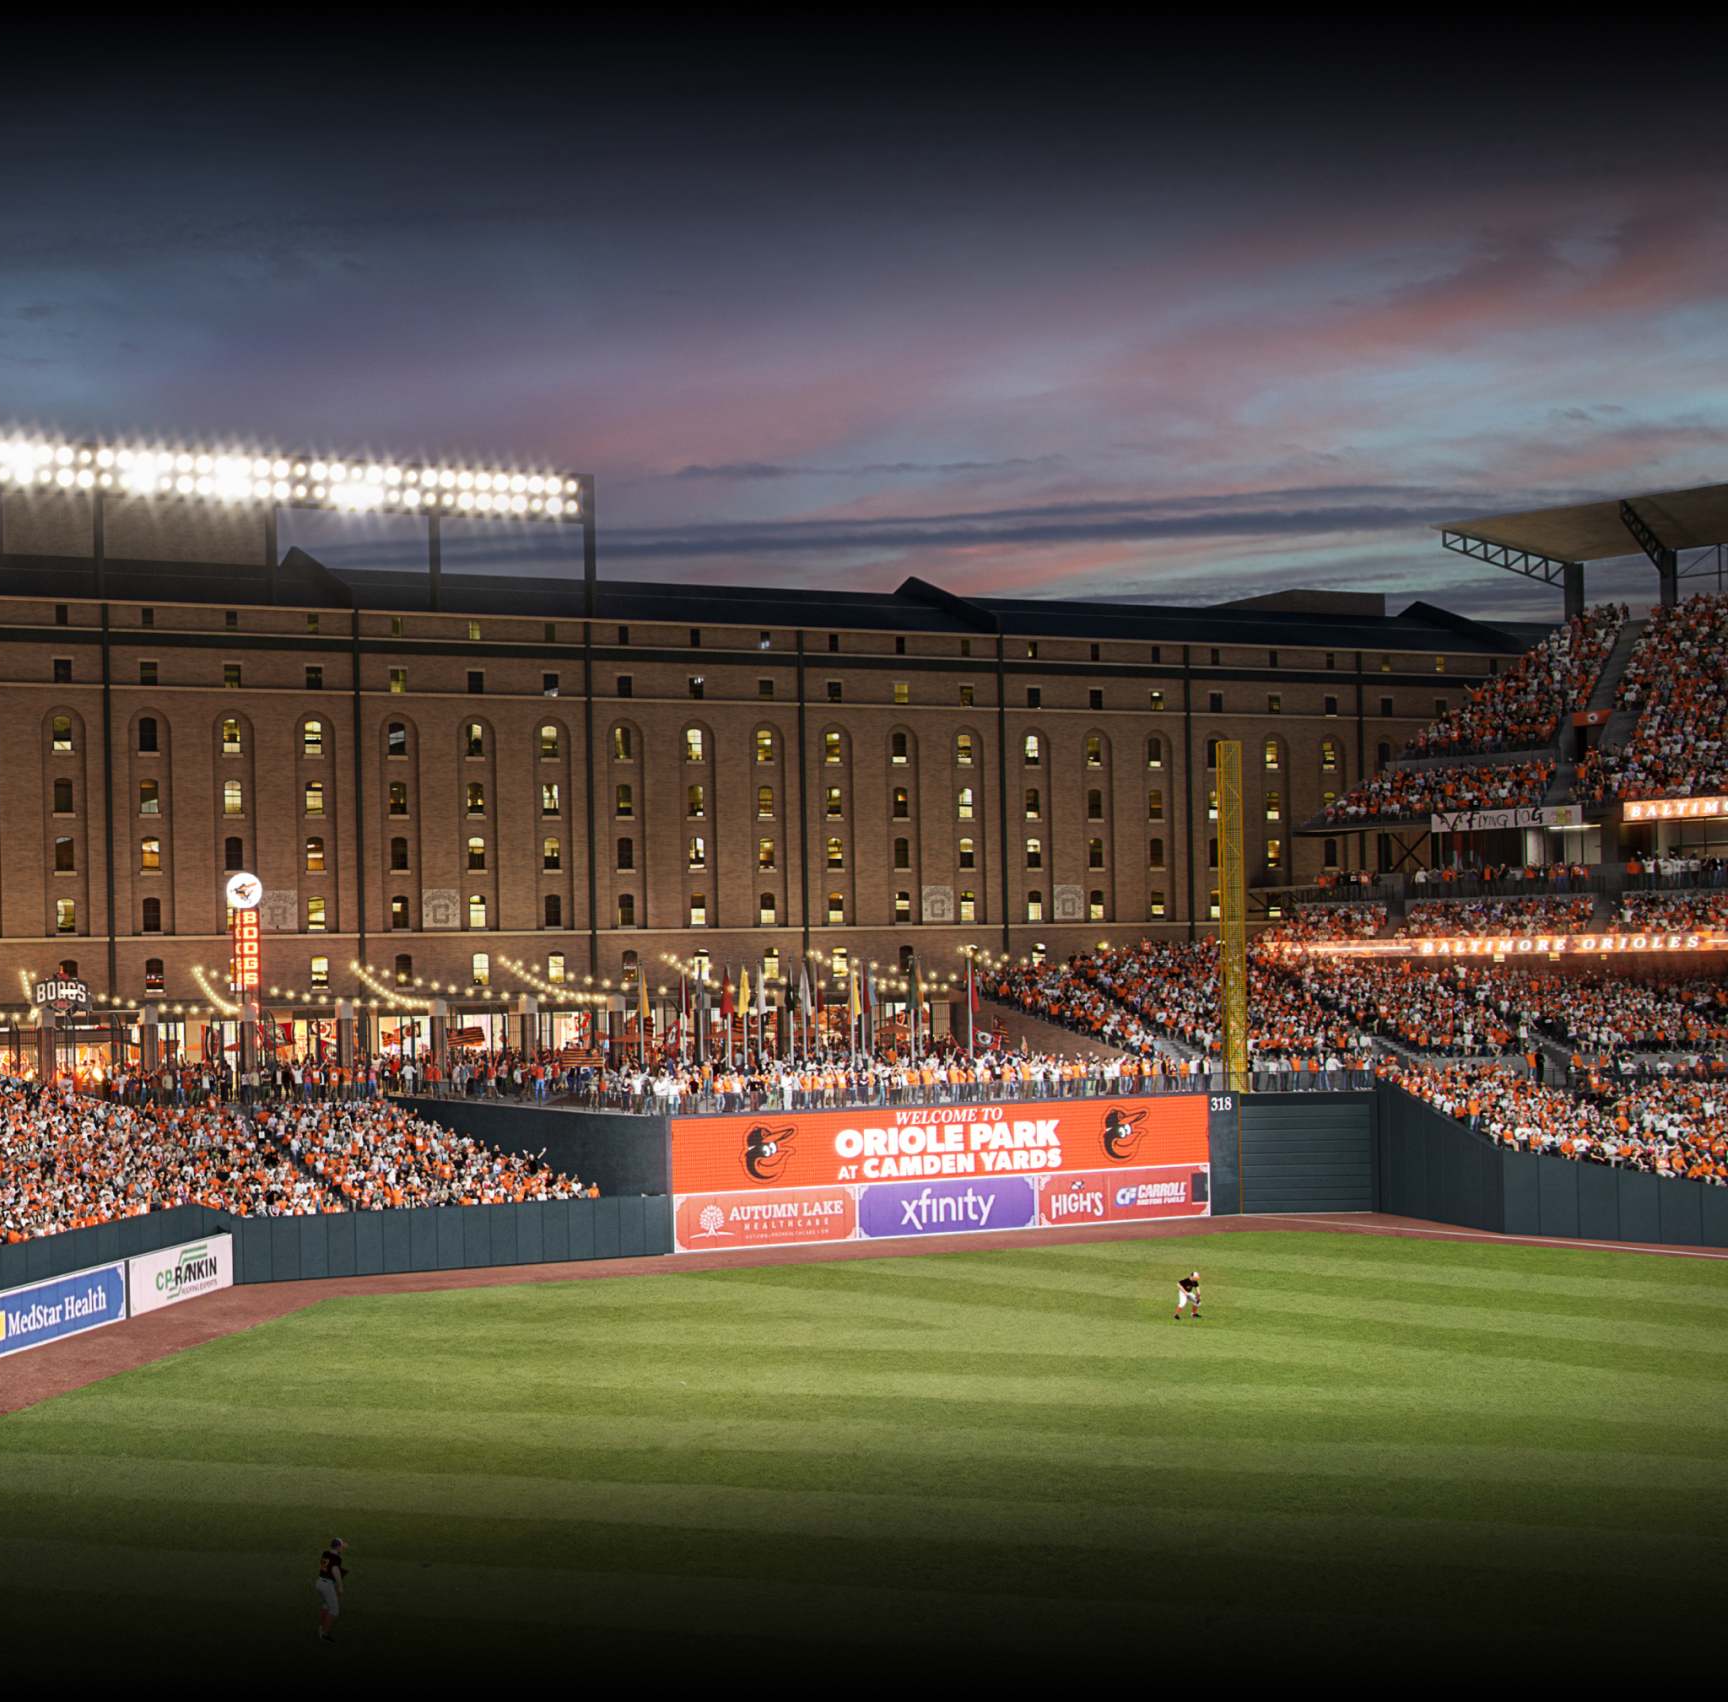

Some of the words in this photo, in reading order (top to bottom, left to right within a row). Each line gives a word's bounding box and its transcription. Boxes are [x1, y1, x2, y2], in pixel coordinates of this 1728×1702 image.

[1514, 807, 1544, 828] DOG
[1422, 939, 1566, 954] BALTIMORE
[1583, 936, 1700, 950] ORIOLES
[1210, 1096, 1232, 1112] 318
[896, 1108, 977, 1125] WELCOME
[981, 1107, 1003, 1122] TO
[835, 1124, 967, 1158] ORIOLE
[971, 1119, 1061, 1151] PARK
[838, 1164, 859, 1180] AT
[863, 1152, 976, 1178] CAMDEN
[980, 1148, 1062, 1171] YARDS
[1136, 1182, 1187, 1199] CARROLL
[1136, 1197, 1163, 1206] MOTOR
[1164, 1195, 1186, 1204] FUELS
[729, 1203, 799, 1221] AUTUMN
[803, 1200, 844, 1217] LAKE
[900, 1187, 996, 1230] xfinity
[1051, 1191, 1105, 1220] HIGH'S
[744, 1217, 829, 1230] HEALTHCARE
[175, 1256, 217, 1286] RANKIN
[8, 1303, 63, 1337] MedStar
[64, 1285, 107, 1321] Health
